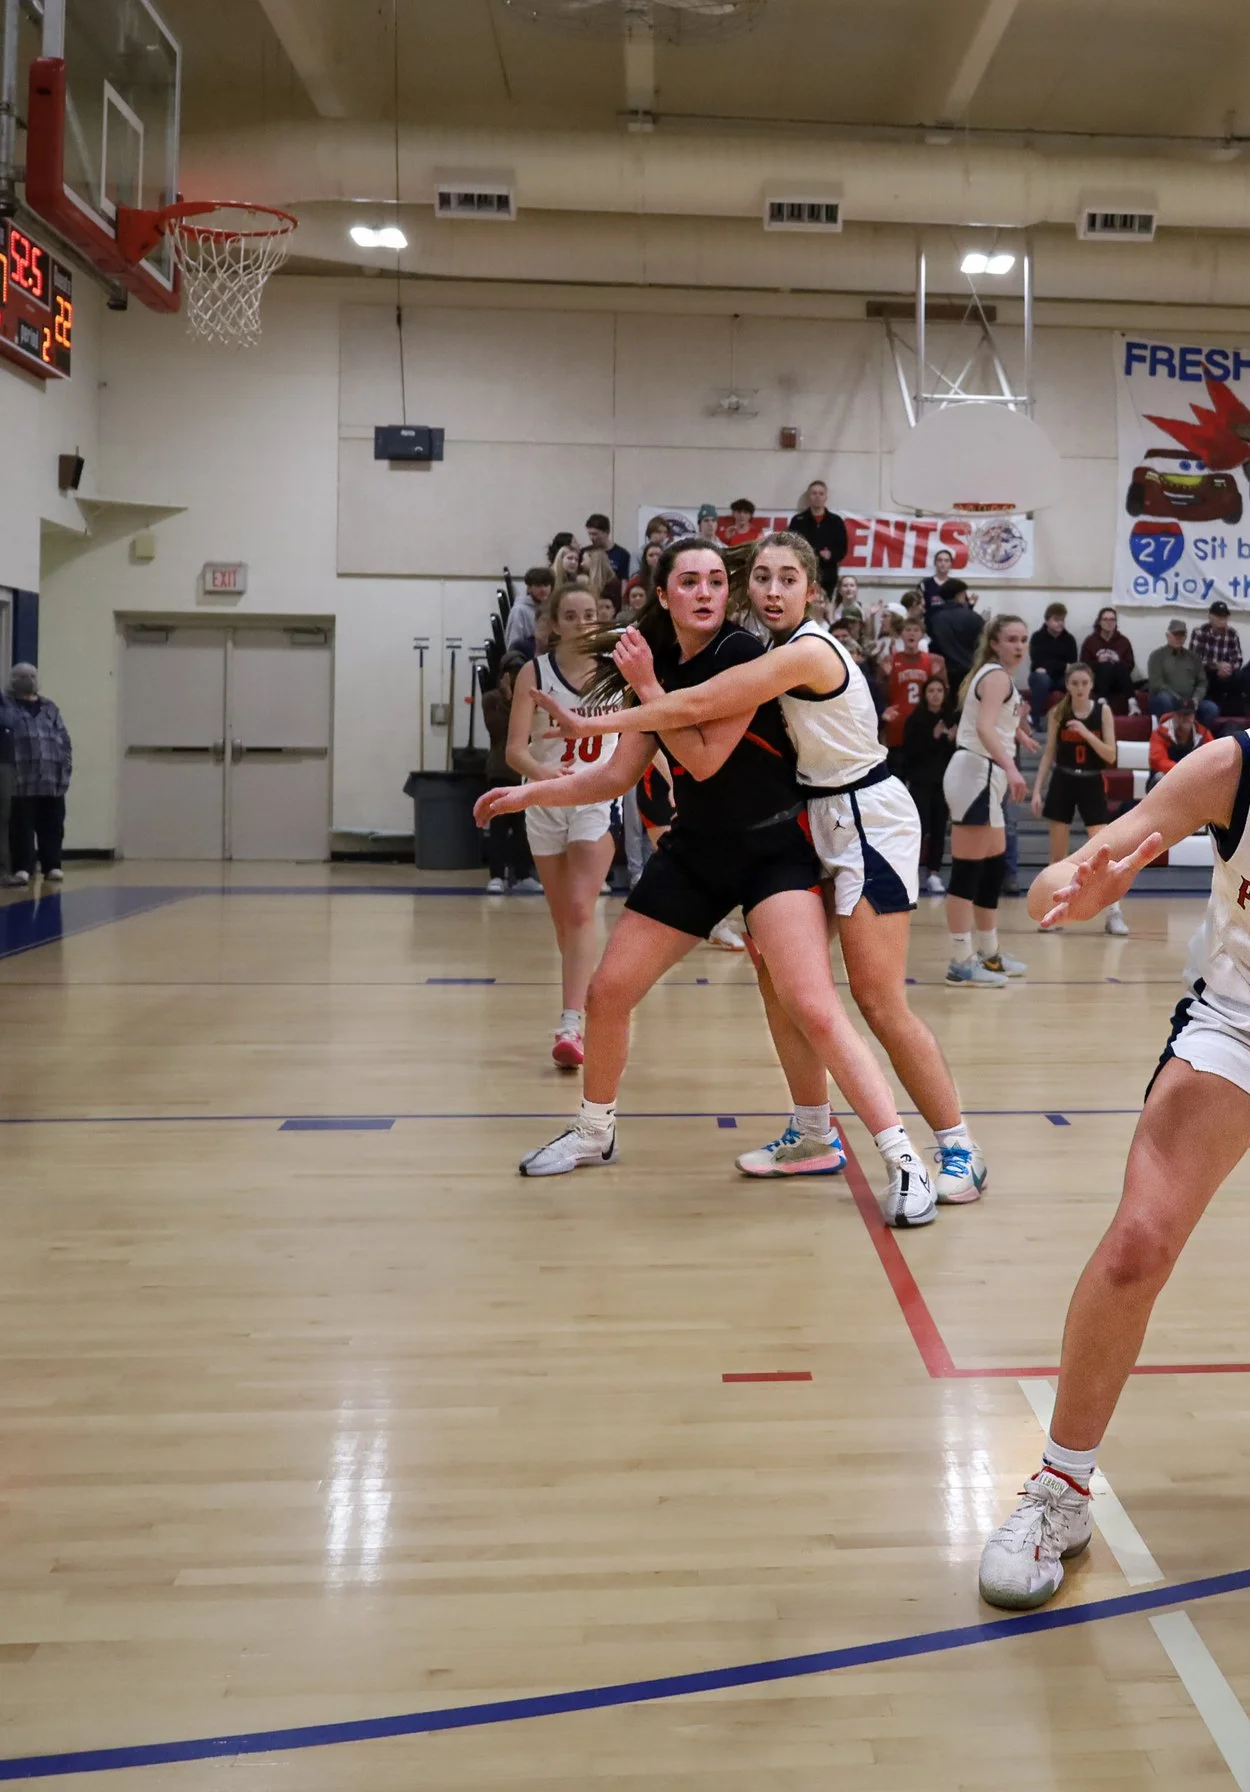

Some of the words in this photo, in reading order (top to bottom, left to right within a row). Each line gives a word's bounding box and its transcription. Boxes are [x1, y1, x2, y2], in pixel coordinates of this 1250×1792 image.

[55, 295, 73, 348] 22
[42, 326, 51, 363] 2
[1138, 537, 1176, 562] 27
[1193, 536, 1227, 561] Sit
[212, 568, 237, 588] EXIT
[1133, 572, 1215, 600] enjoy
[907, 682, 921, 704] 2
[560, 734, 603, 763] 10
